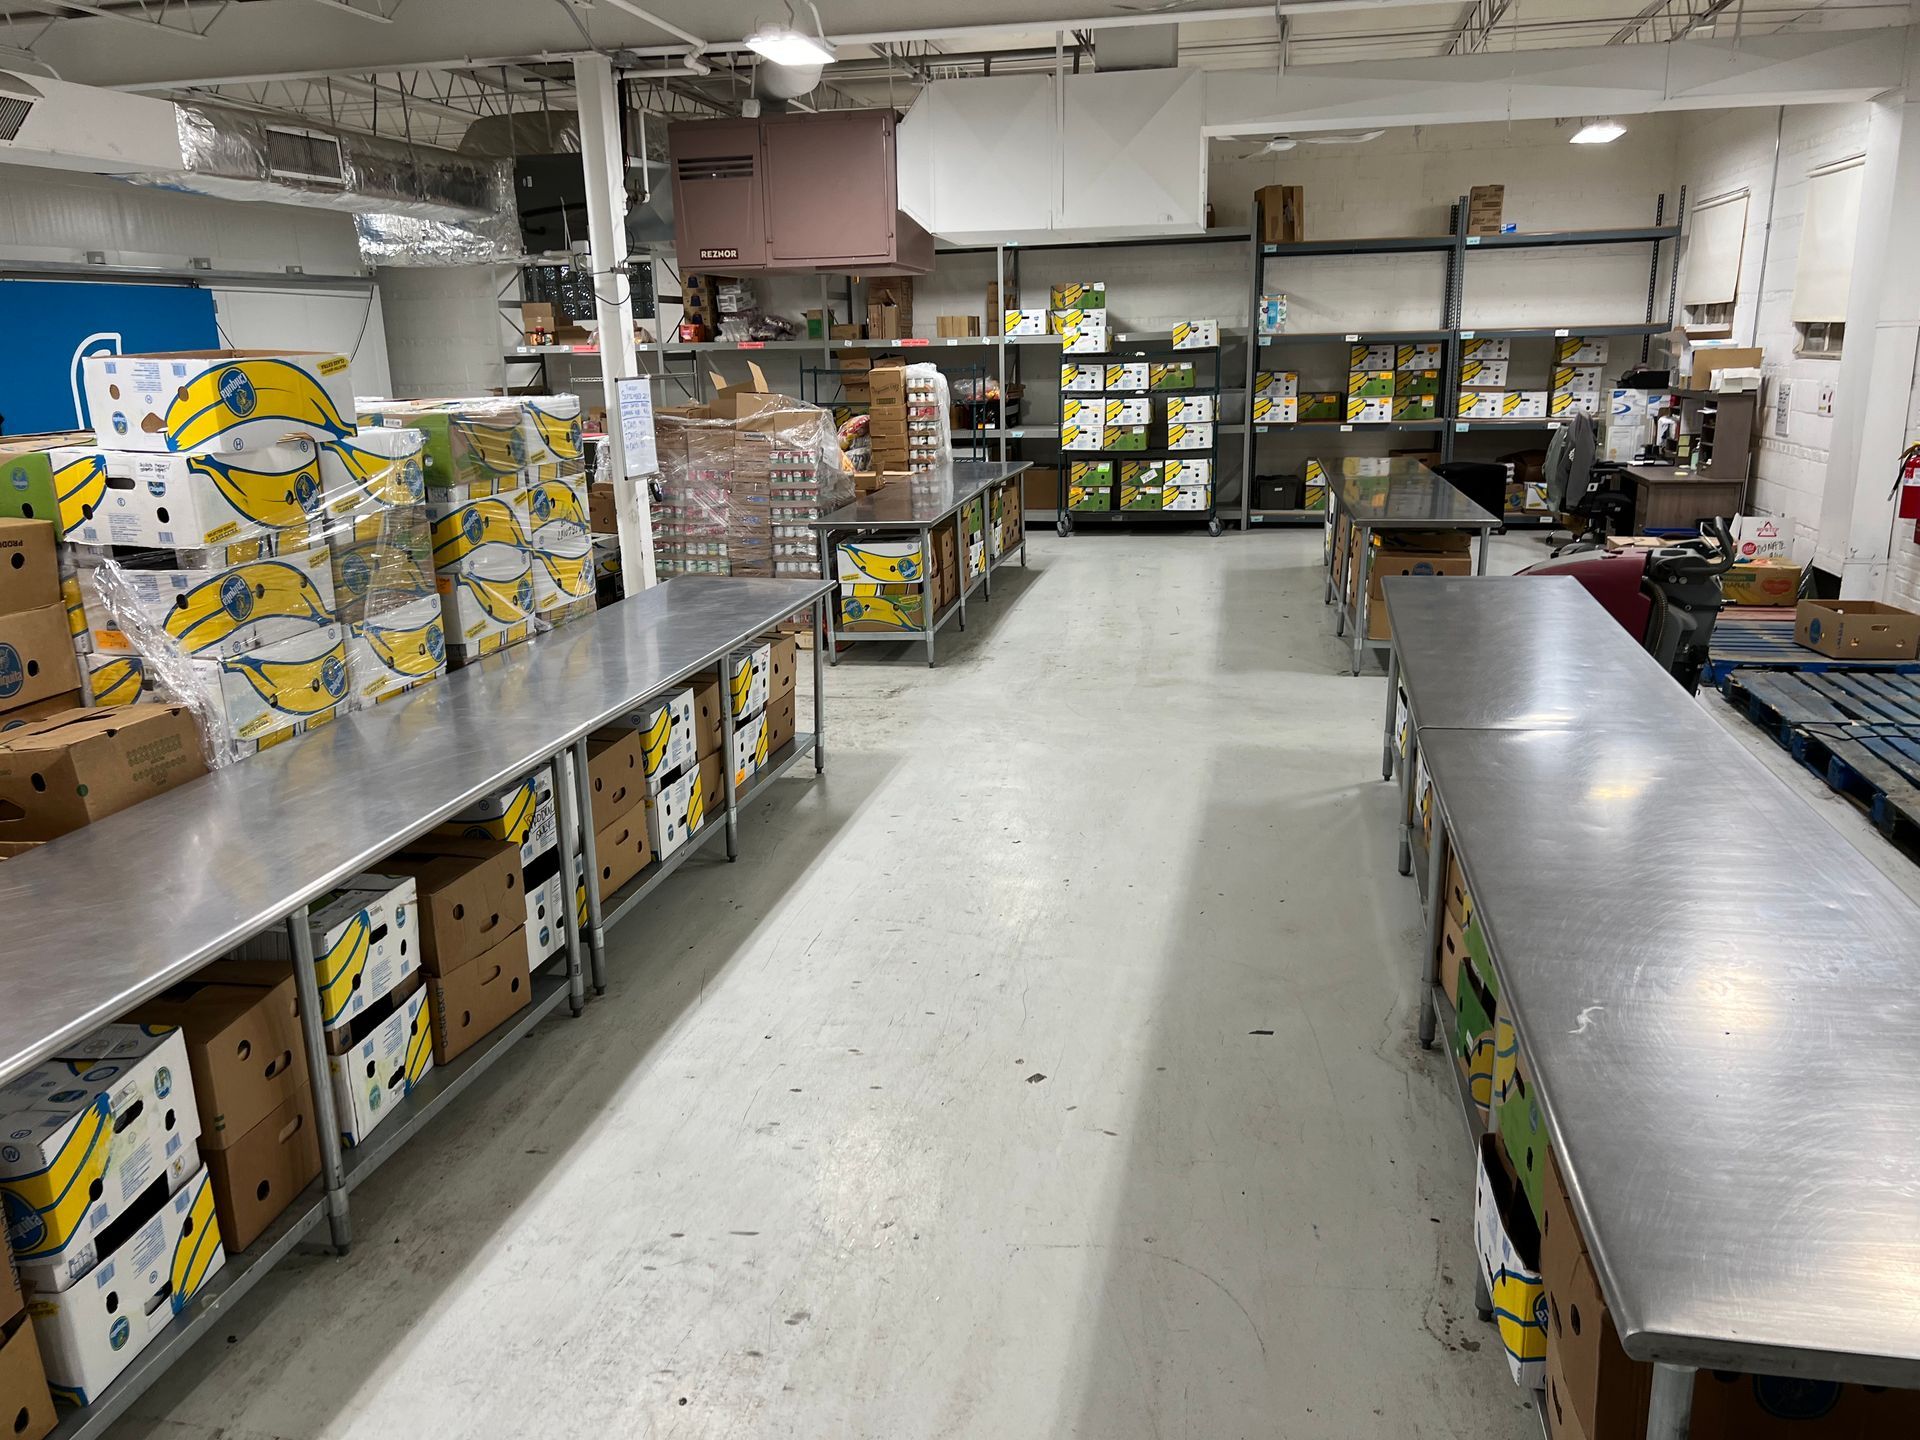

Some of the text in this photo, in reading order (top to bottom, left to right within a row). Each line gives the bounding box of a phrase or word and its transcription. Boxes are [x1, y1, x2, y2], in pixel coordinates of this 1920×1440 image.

[701, 249, 738, 259] REZNOR
[221, 372, 248, 401] Chiquita
[221, 576, 246, 606] Chiquita
